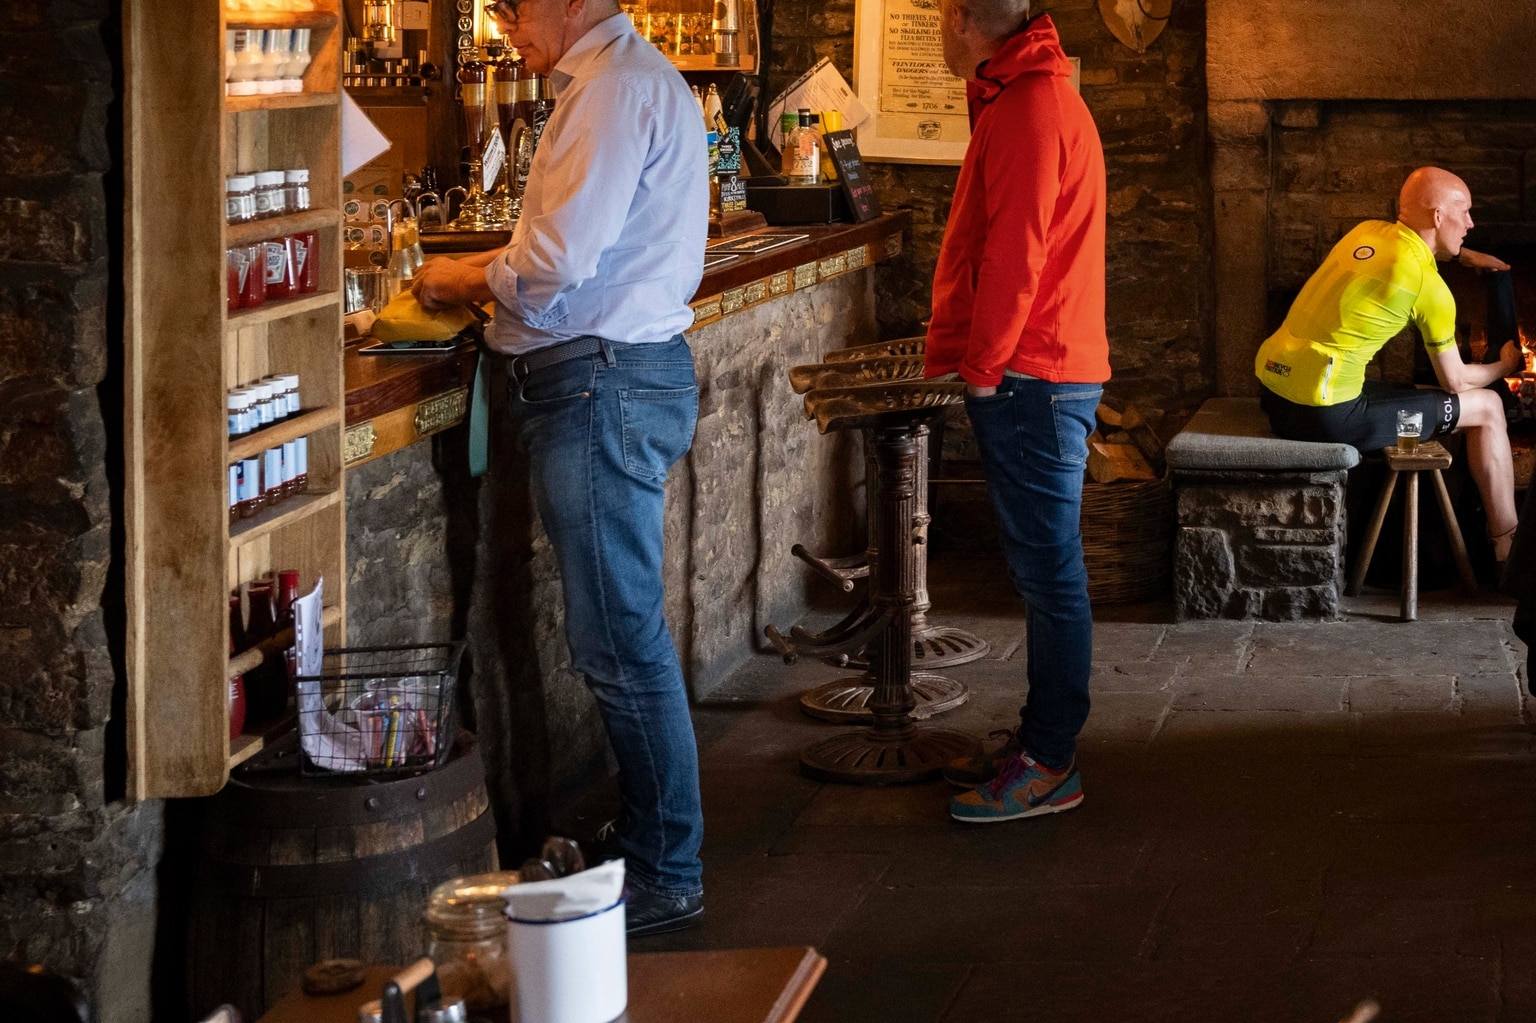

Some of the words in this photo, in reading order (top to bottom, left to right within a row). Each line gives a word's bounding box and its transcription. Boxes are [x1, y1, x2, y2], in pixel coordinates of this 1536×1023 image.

[911, 20, 938, 28] TINKERS
[900, 28, 931, 36] SKULKING
[1443, 396, 1455, 423] COL
